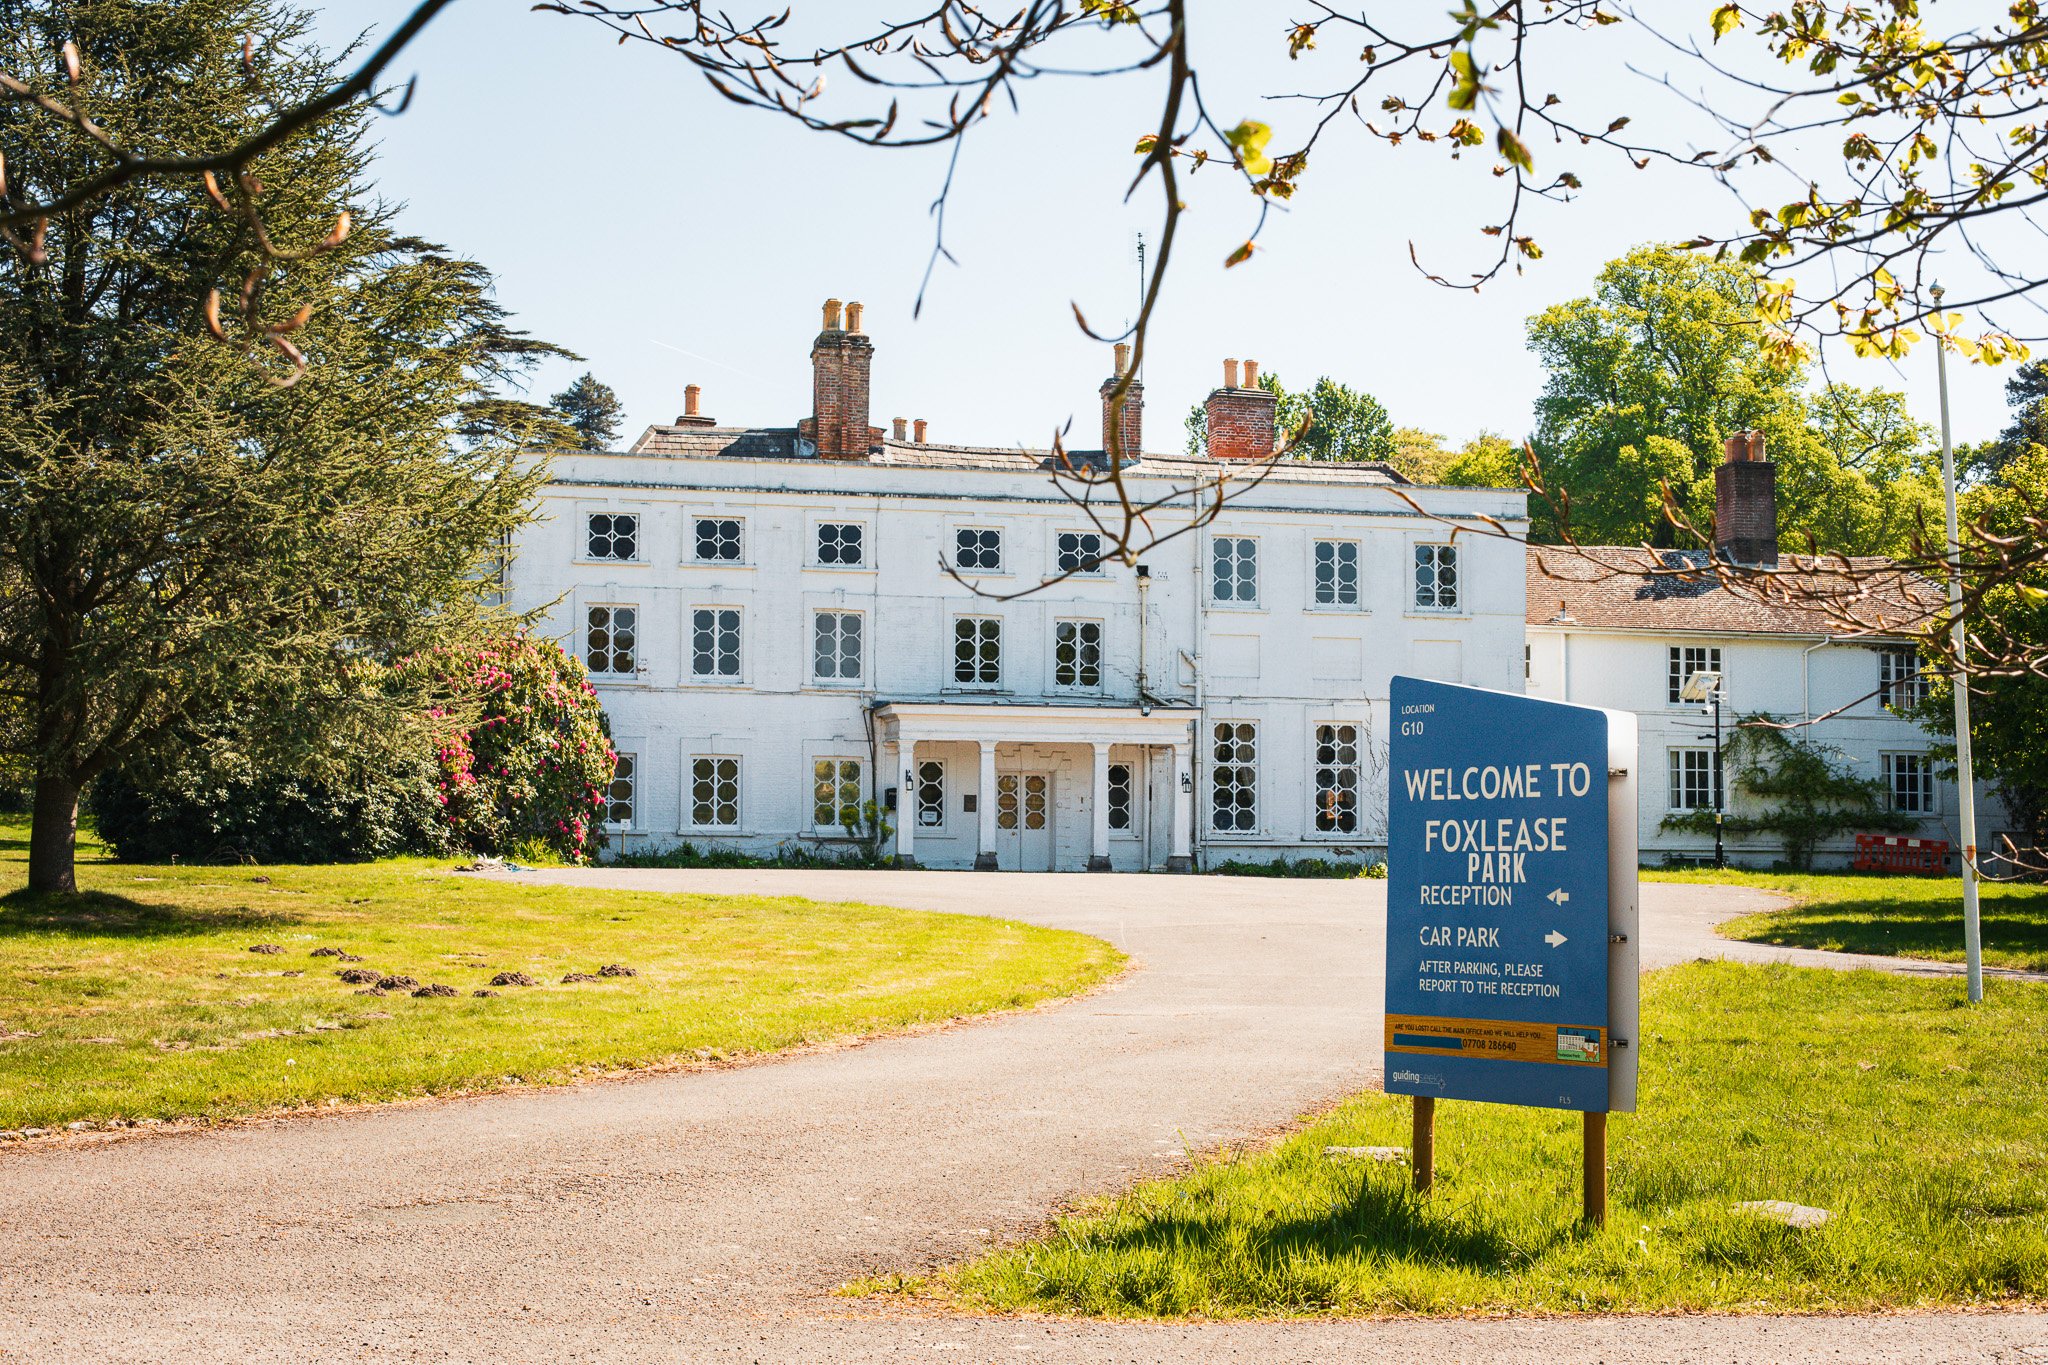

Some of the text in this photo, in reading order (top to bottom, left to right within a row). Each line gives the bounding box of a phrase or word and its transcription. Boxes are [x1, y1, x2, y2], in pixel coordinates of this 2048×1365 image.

[1402, 704, 1435, 714] LOCATION
[1402, 721, 1424, 736] G10
[1404, 762, 1590, 801] WELCOME TO
[1425, 818, 1567, 852] FOXLEASE
[1468, 853, 1526, 883] PARK
[1420, 885, 1512, 906] RECEPTION
[1419, 926, 1499, 948] CAR PARK
[1419, 961, 1543, 978] AFTER PARKING, PLEASE
[1419, 979, 1560, 998] REPORT TO THE RECEPTION
[1462, 1038, 1517, 1051] 07708 286640
